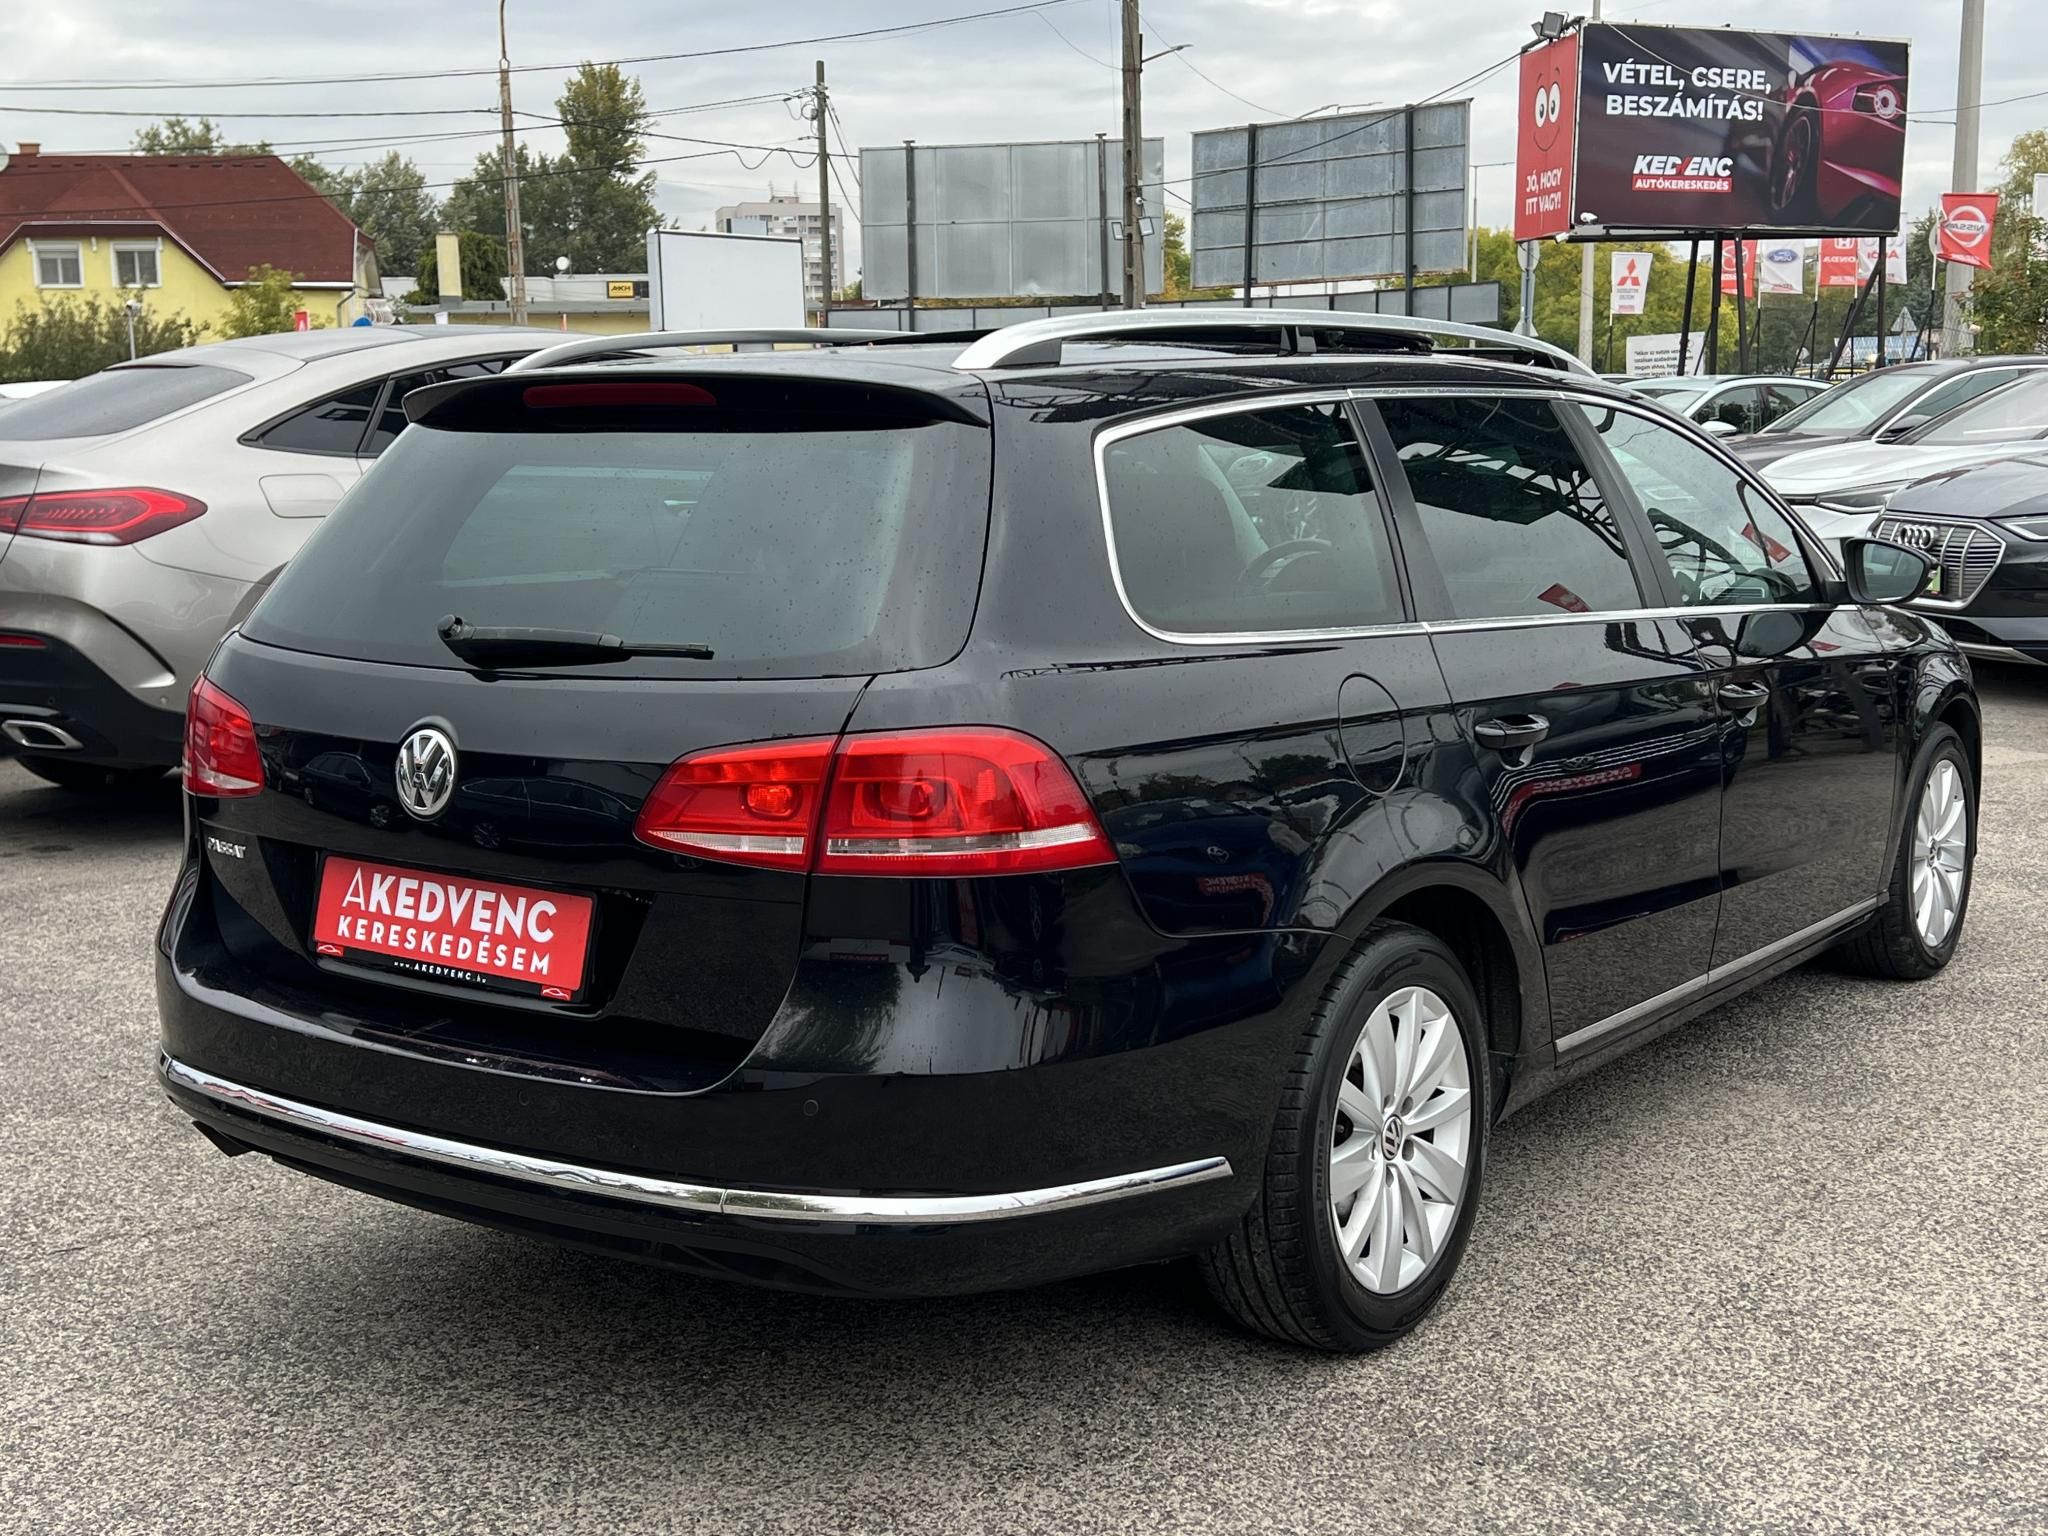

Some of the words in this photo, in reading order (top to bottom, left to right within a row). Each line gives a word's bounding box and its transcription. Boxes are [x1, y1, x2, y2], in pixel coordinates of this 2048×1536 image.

[1603, 58, 1685, 90] VÉTEL,
[1691, 66, 1772, 94] CSERE,
[1606, 92, 1764, 121] BESZÁMÍTÁS!
[1525, 169, 1539, 194] JÓ,
[1540, 167, 1563, 190] HOGY
[1635, 177, 1730, 191] AUTÓKERESKEDÉS
[1525, 196, 1538, 216] ITT
[1538, 191, 1562, 213] VAGY!
[341, 866, 558, 944] AKEDVENC
[337, 914, 550, 976] KERESKEDÉSEM
